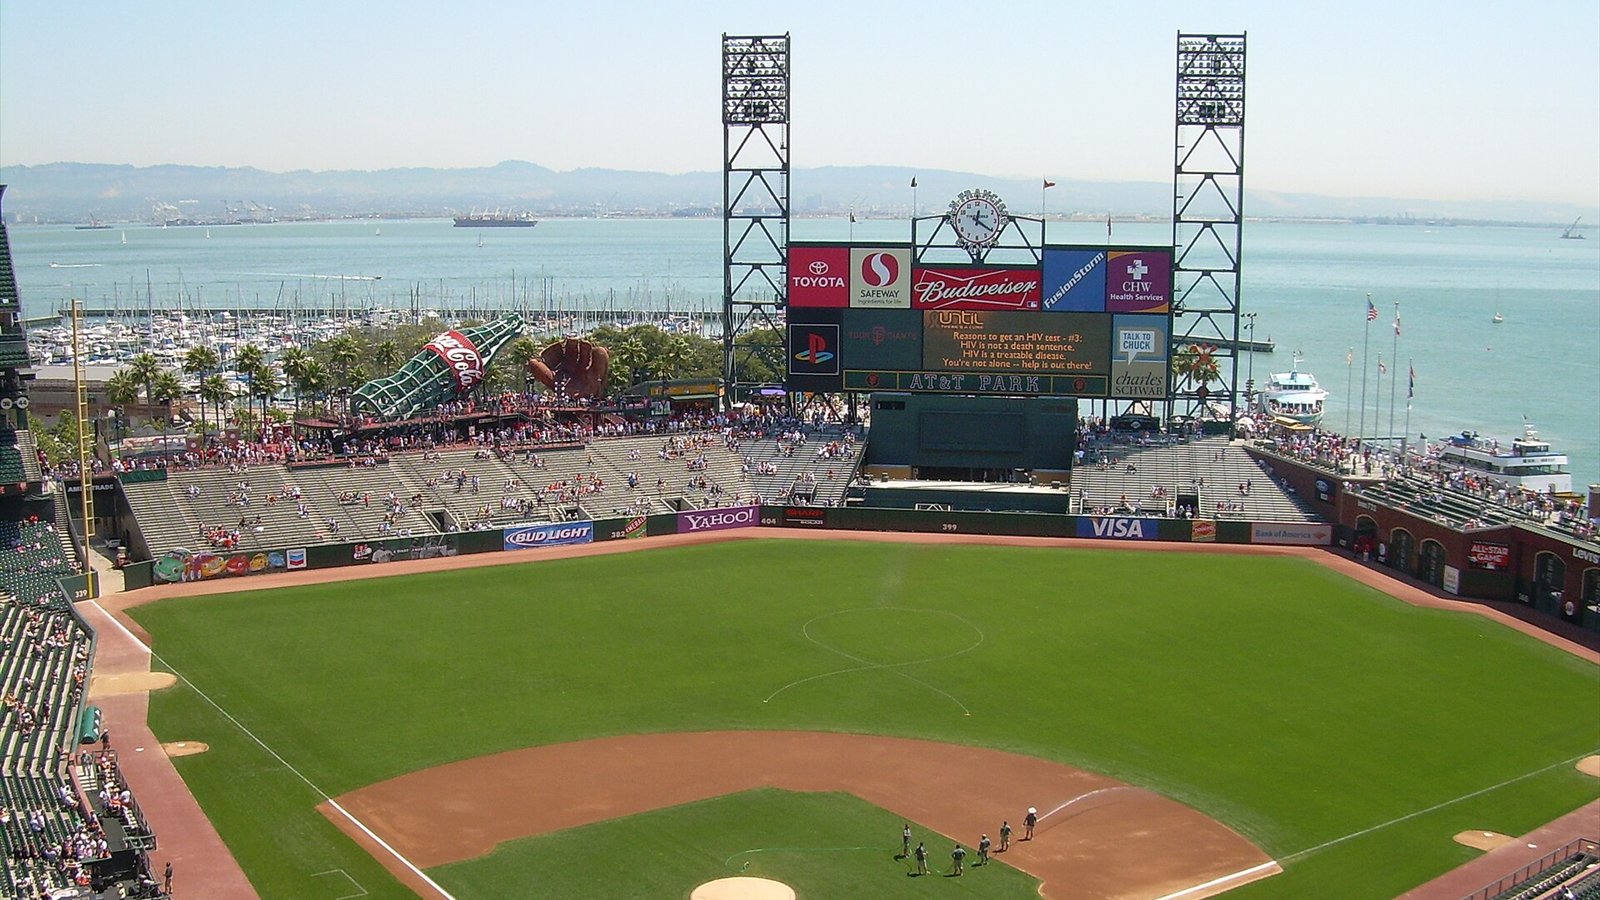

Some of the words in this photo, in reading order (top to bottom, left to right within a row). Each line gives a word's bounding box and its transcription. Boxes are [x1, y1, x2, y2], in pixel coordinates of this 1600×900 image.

[793, 277, 845, 288] TOYOTA
[1044, 251, 1105, 309] FusionStorm
[914, 278, 1037, 304] Budweiser
[1122, 281, 1152, 292] CHW
[860, 290, 900, 298] SAFEWAY
[1110, 293, 1133, 301] Health
[953, 332, 986, 340] Reasons
[988, 333, 998, 341] to
[1000, 334, 1013, 342] get
[1026, 333, 1043, 341] HIV
[1045, 334, 1060, 342] test
[1123, 333, 1140, 341] TALK
[1141, 333, 1151, 341] TO
[960, 341, 977, 349] HIV
[979, 341, 985, 349] is
[987, 342, 1002, 350] not
[1010, 342, 1034, 351] death
[1036, 343, 1075, 351] sentence.
[1123, 341, 1151, 350] CHUCK
[963, 350, 980, 358] HIV
[996, 351, 1033, 360] treatable
[1035, 352, 1066, 360] disease.
[943, 358, 970, 366] You're
[972, 359, 987, 367] not
[989, 359, 1011, 368] alone
[1022, 360, 1040, 370] help
[1041, 361, 1048, 369] is
[1050, 361, 1065, 369] out
[1066, 361, 1092, 370] there!
[910, 373, 965, 390] AT&T
[979, 375, 1039, 391] PARK
[1115, 371, 1163, 386] charles
[1115, 386, 1163, 396] SCHWAB
[684, 508, 754, 530] YAHOO!
[1091, 519, 1143, 537] VISA
[515, 530, 546, 543] BUD
[547, 527, 591, 540] LIGHT
[611, 530, 625, 538] 382
[1274, 530, 1282, 538] of
[1282, 530, 1311, 538] America
[1471, 544, 1509, 555] ALL-STAR
[1476, 553, 1502, 563] GAME
[75, 589, 88, 598] 339
